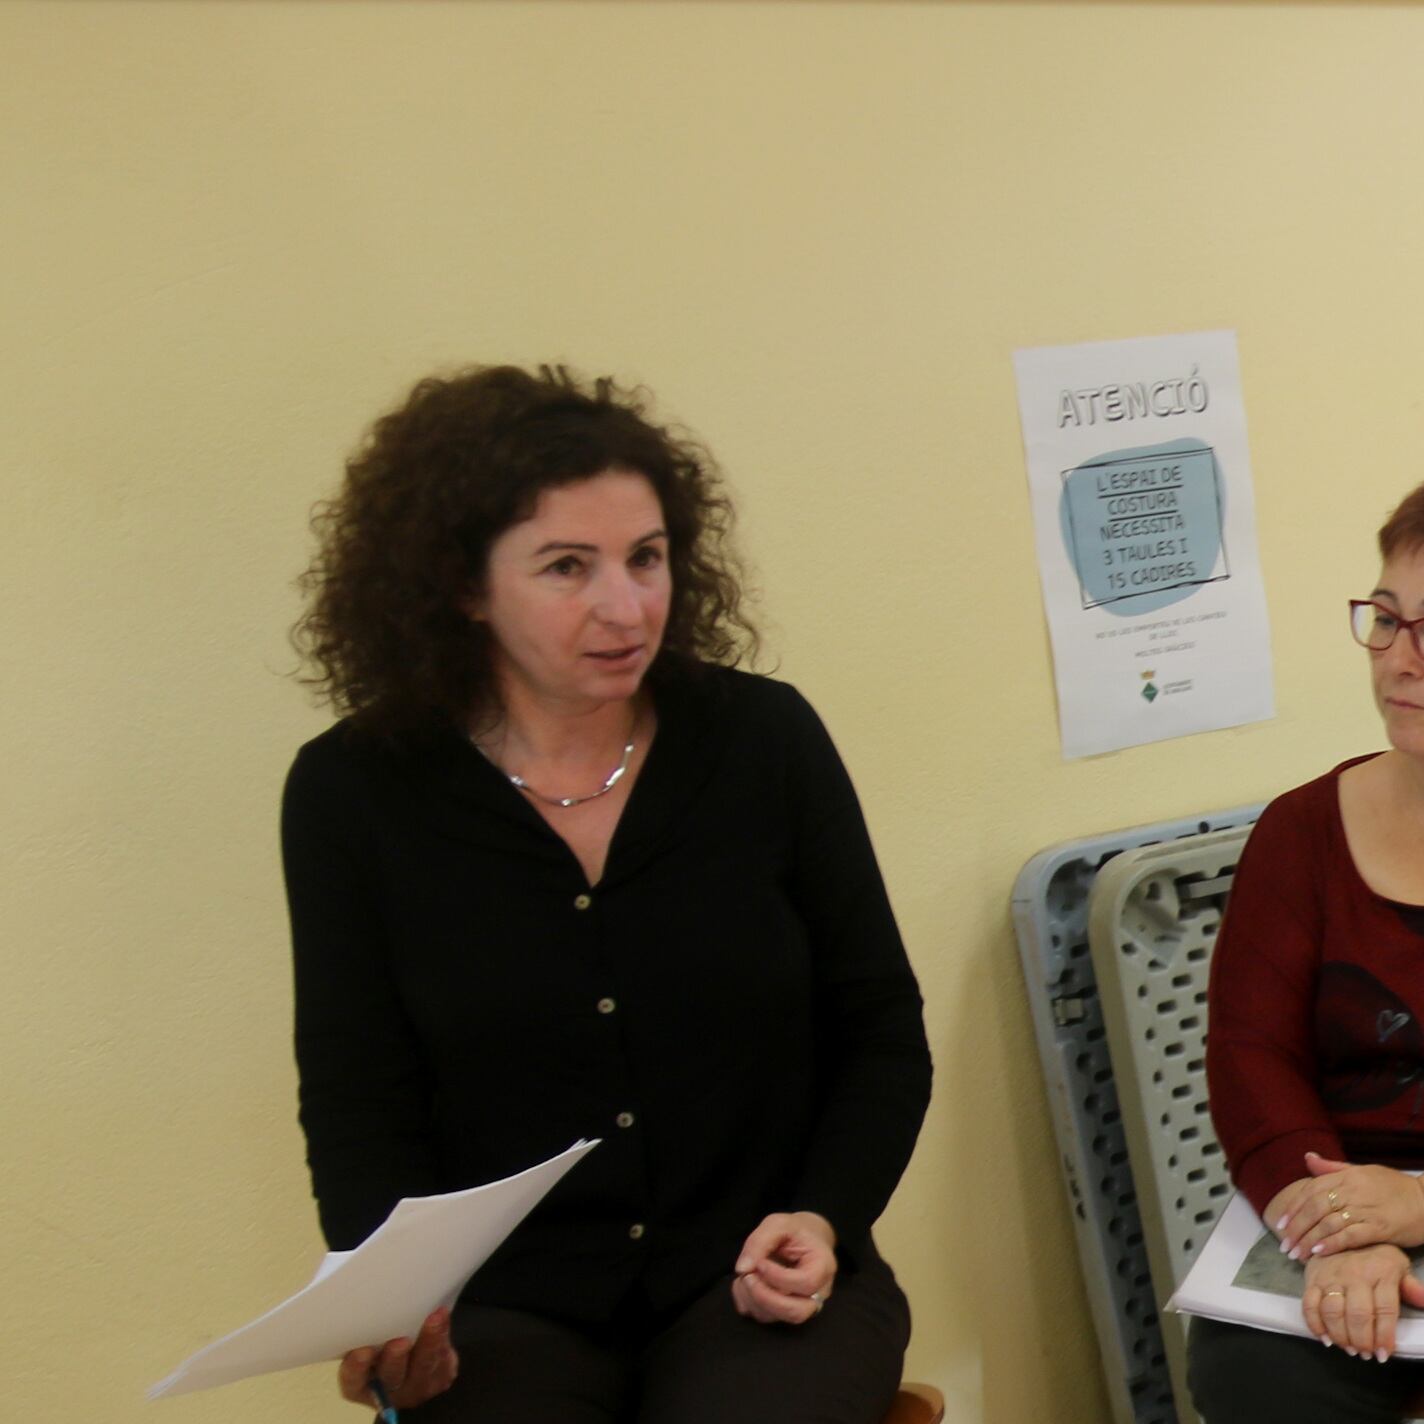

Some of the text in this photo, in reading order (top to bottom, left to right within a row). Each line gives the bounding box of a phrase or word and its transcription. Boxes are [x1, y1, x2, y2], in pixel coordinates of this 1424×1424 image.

[1059, 366, 1208, 428] ATENCIÓ
[1097, 466, 1181, 491] L'ESPAI DE
[1108, 492, 1176, 514] COSTURA
[1101, 516, 1184, 540] NECESSITA
[1103, 537, 1188, 566] 3 TAULES I
[1108, 562, 1195, 589] 15 CADIRES
